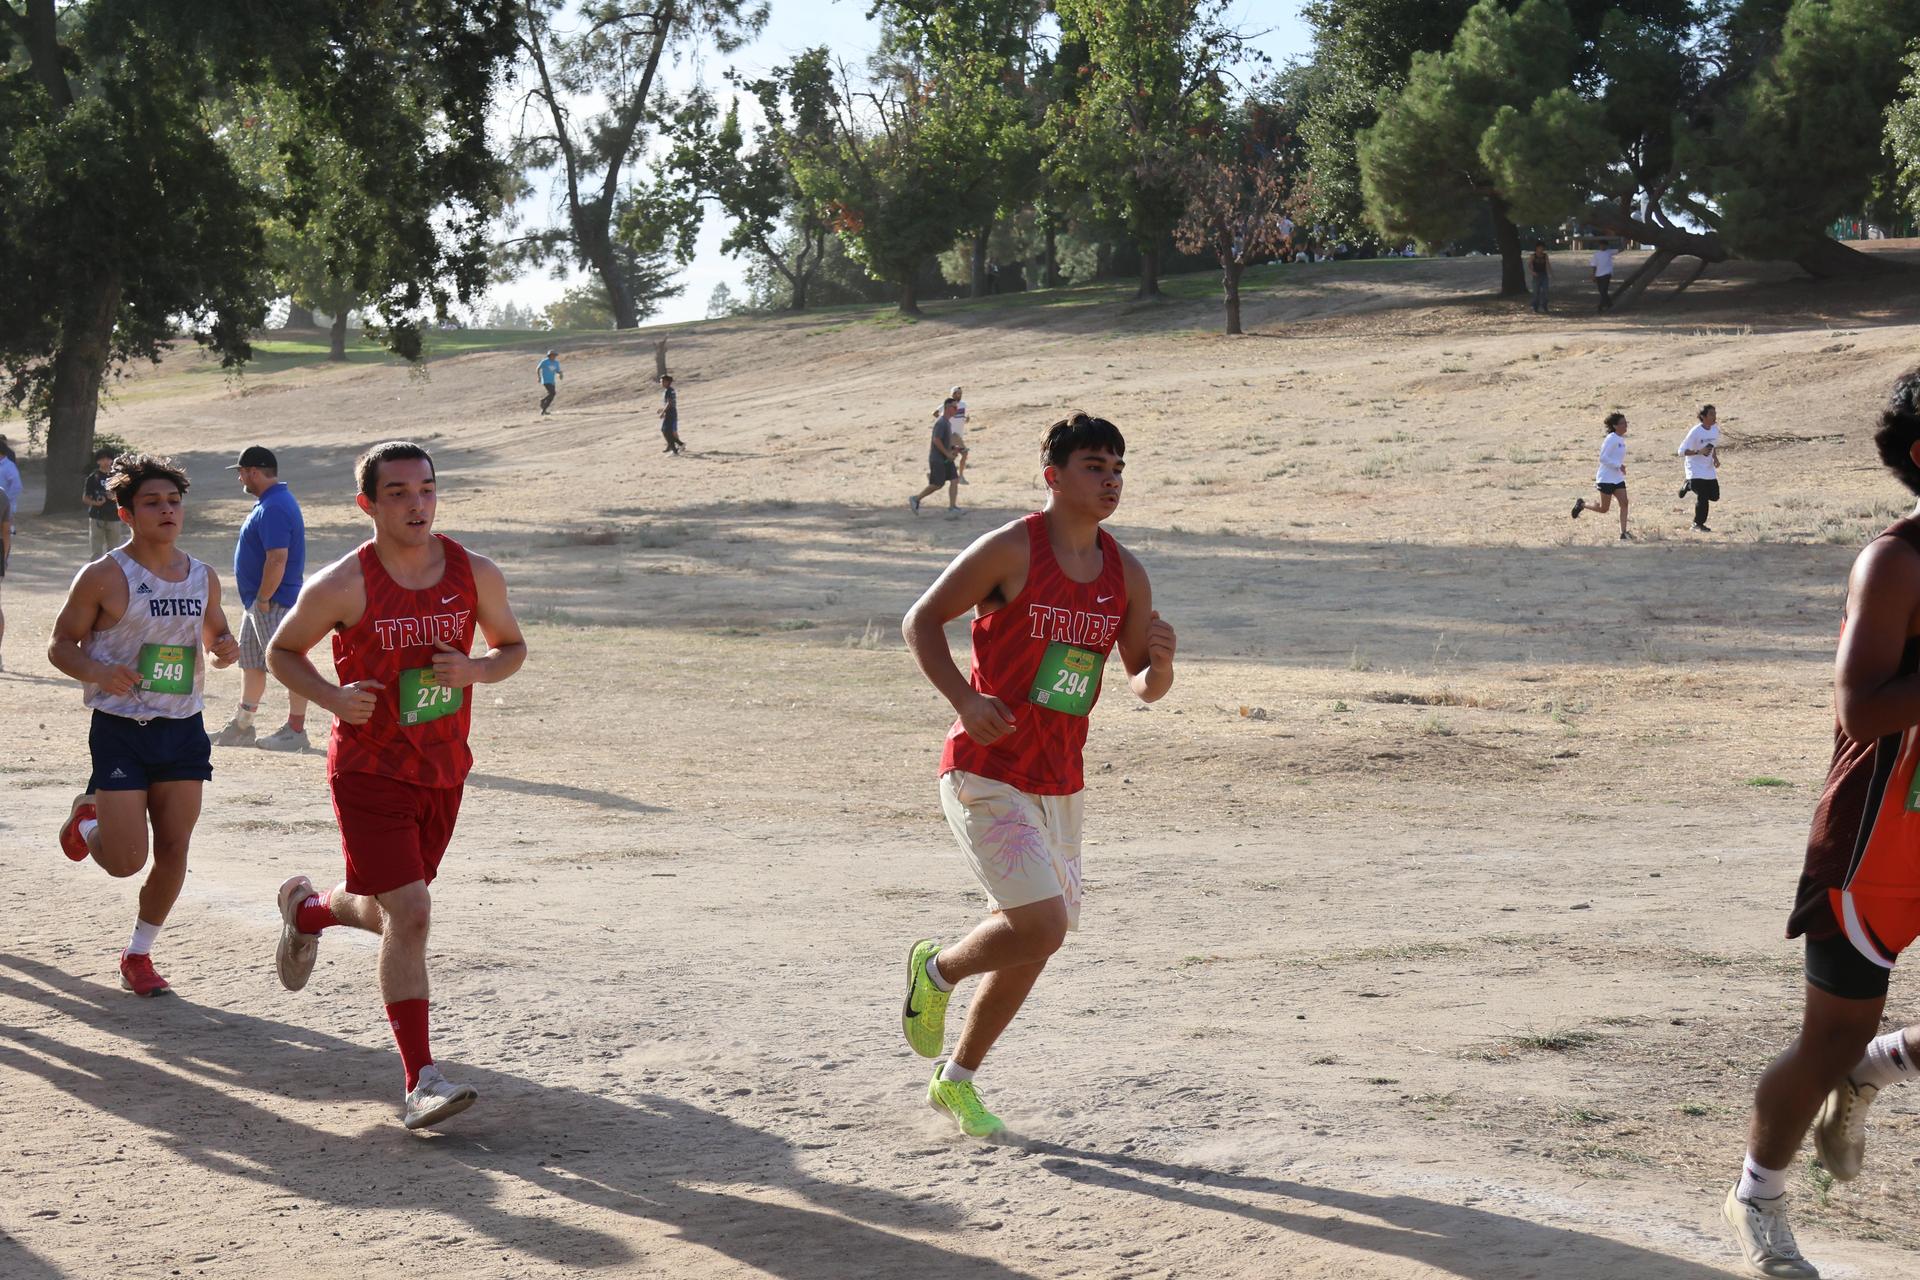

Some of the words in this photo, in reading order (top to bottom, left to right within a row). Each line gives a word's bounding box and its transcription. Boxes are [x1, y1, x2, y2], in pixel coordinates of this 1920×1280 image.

[149, 598, 202, 617] AZTECS
[375, 610, 471, 650] TRIBE
[1029, 603, 1121, 646] TRIBE
[152, 662, 184, 681] 549
[1052, 669, 1090, 698] 294
[417, 685, 452, 708] 279
